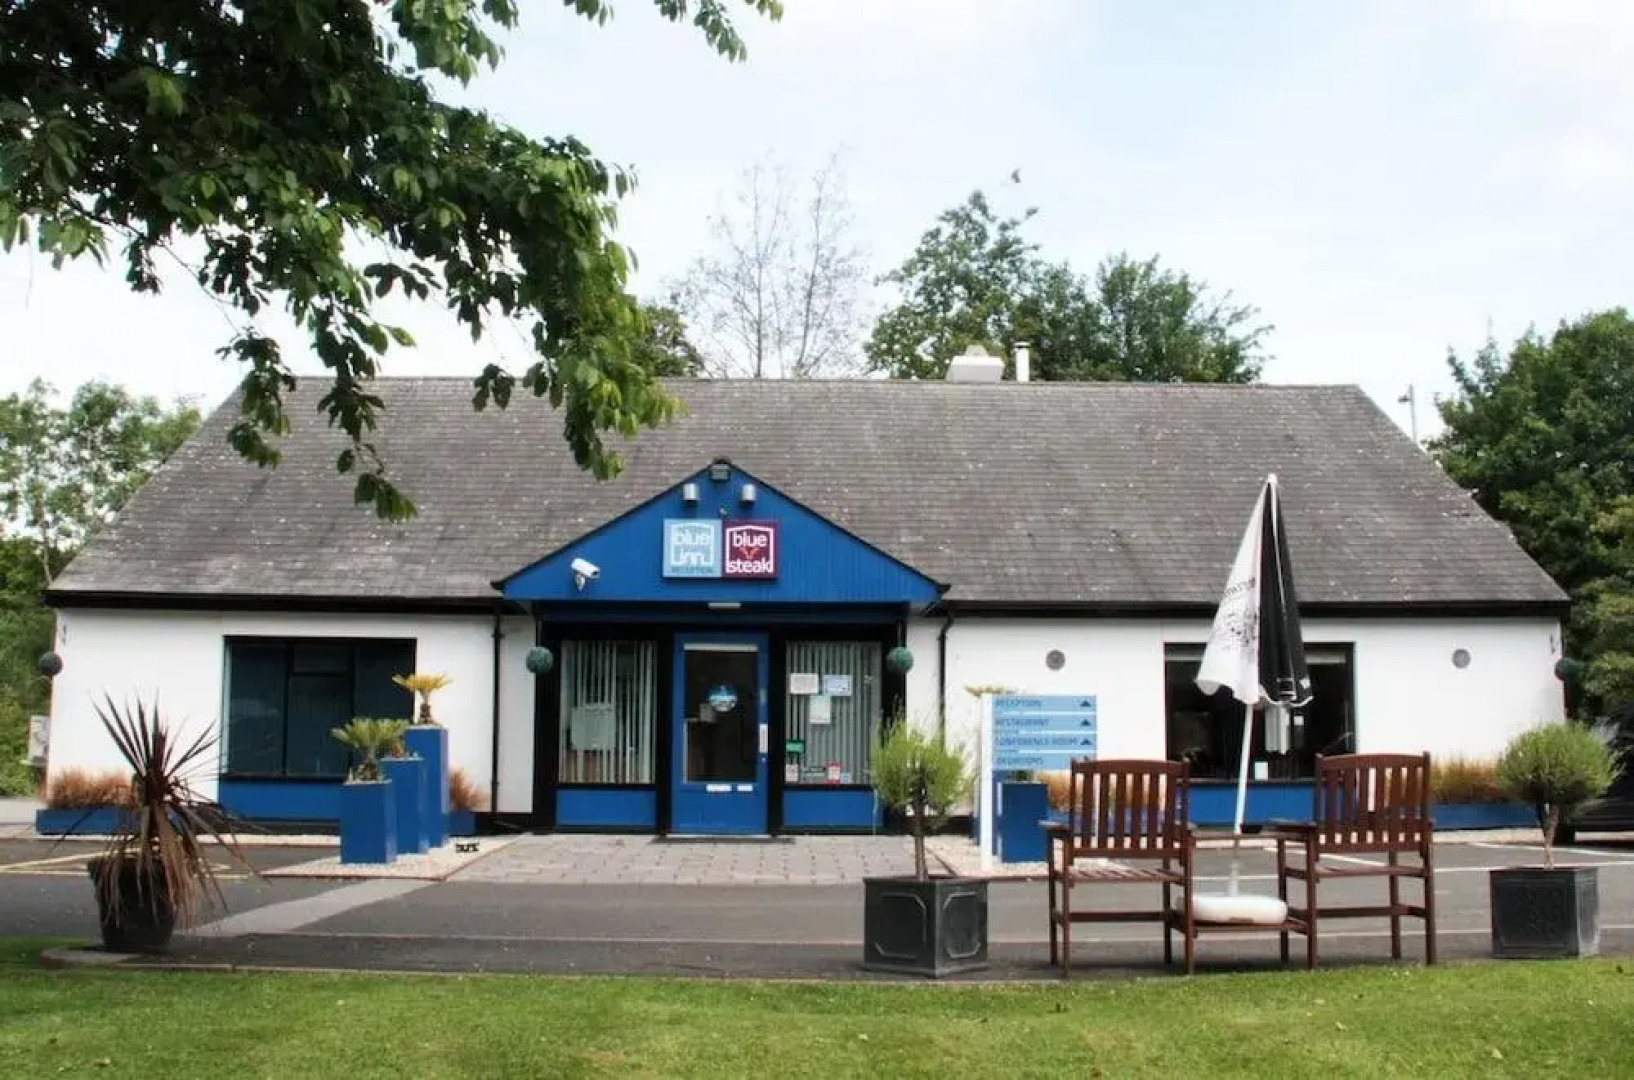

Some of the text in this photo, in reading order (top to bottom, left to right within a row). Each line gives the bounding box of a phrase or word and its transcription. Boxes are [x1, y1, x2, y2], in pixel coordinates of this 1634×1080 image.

[733, 532, 768, 547] blue
[728, 557, 773, 573] steak
[995, 718, 1049, 726] RESTAURANT
